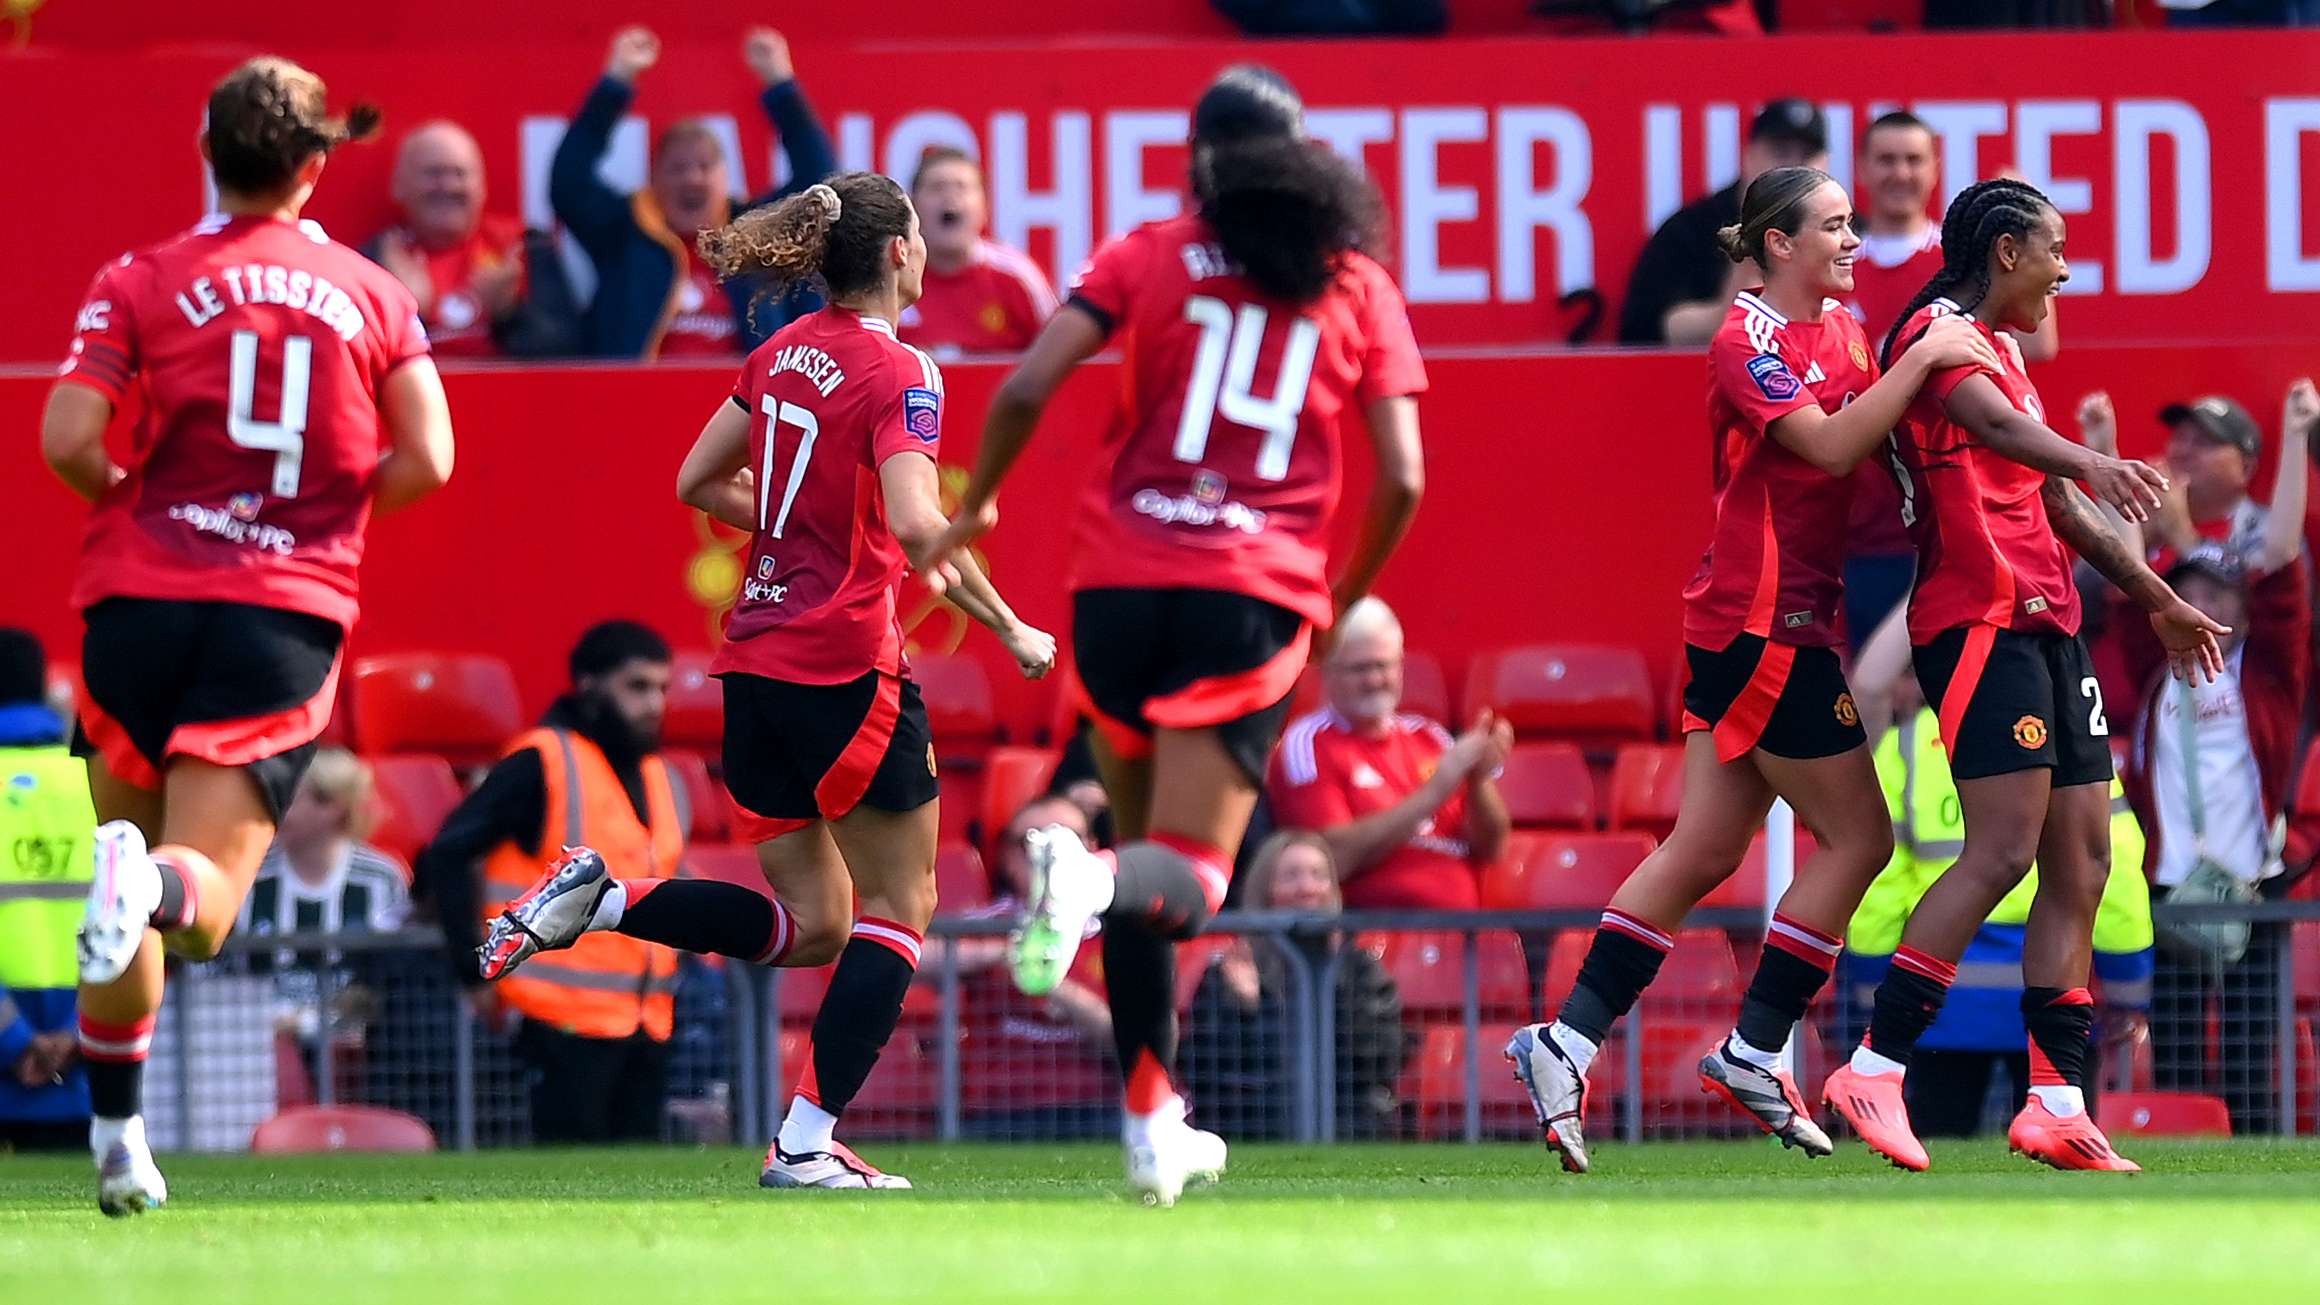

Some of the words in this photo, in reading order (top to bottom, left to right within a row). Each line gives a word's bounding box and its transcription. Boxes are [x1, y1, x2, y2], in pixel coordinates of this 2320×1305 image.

[521, 104, 1597, 303] MHETER
[1645, 98, 2211, 298] TED
[176, 275, 226, 329] LE
[769, 345, 846, 398] JANSSEN
[226, 329, 313, 500] 4
[760, 393, 819, 540] 17
[1171, 293, 1321, 482] 14
